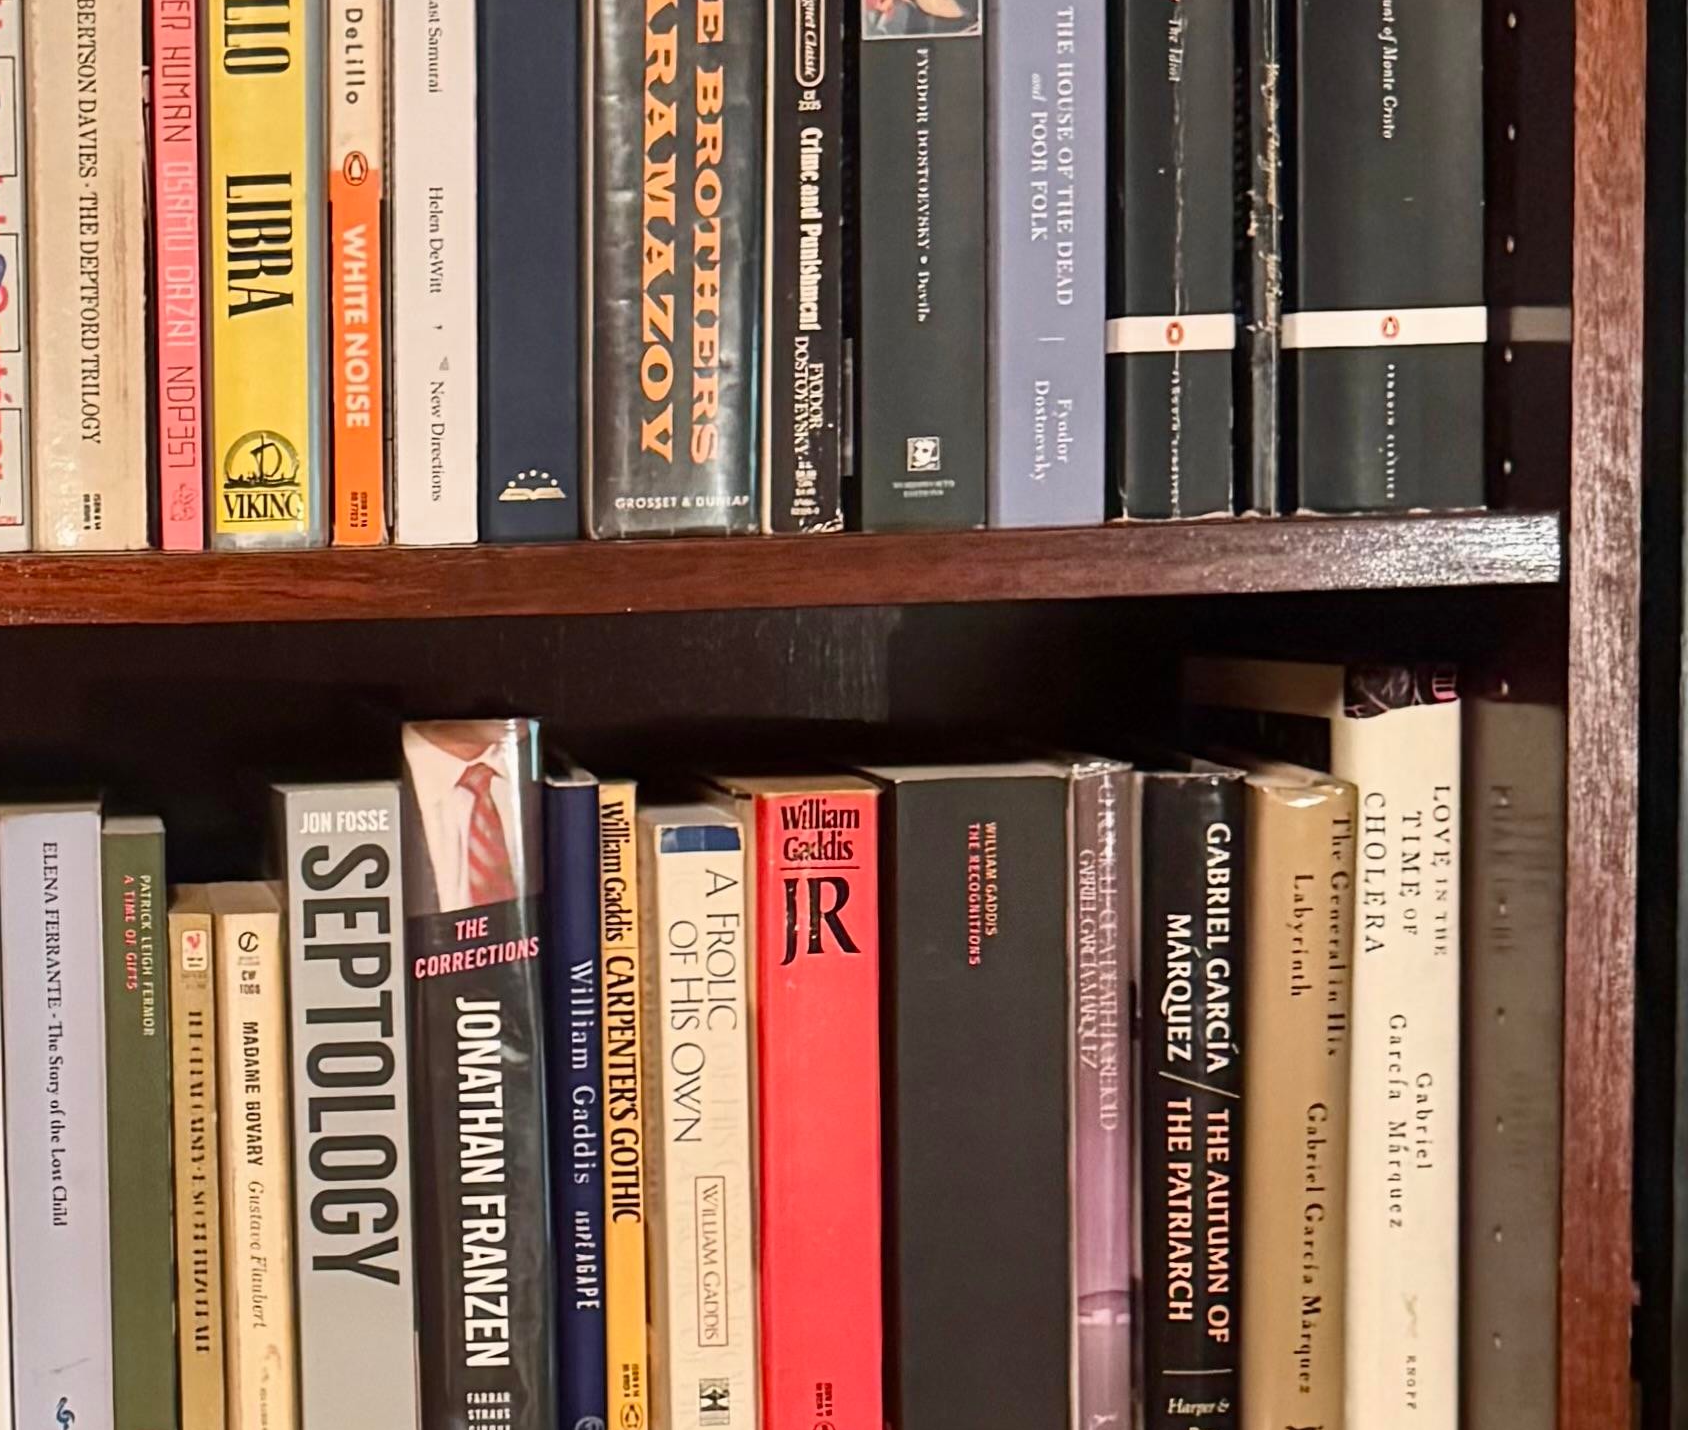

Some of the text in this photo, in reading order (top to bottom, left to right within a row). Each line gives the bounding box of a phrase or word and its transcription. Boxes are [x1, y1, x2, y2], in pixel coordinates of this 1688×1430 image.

[79, 102, 96, 178] DAVIES
[81, 192, 96, 230] THE
[224, 172, 294, 318] LIBRA
[691, 66, 723, 463] BROTHERS
[81, 236, 99, 344] DEPTFORD
[343, 224, 371, 429] WHITE NOISE
[83, 347, 100, 444] TRILOGY
[337, 809, 389, 832] FOSSE
[1362, 792, 1386, 955] CHOLERA
[415, 937, 539, 979] CORRECTIONS
[455, 918, 488, 940] THE
[781, 877, 860, 965] JR
[1206, 822, 1238, 1073] GABRIEL GARCÍA
[1161, 913, 1193, 1062] MÁRQUEZ
[300, 844, 401, 1286] SEPTOLOGY
[456, 997, 509, 1367] JONATHAN FRANZEN
